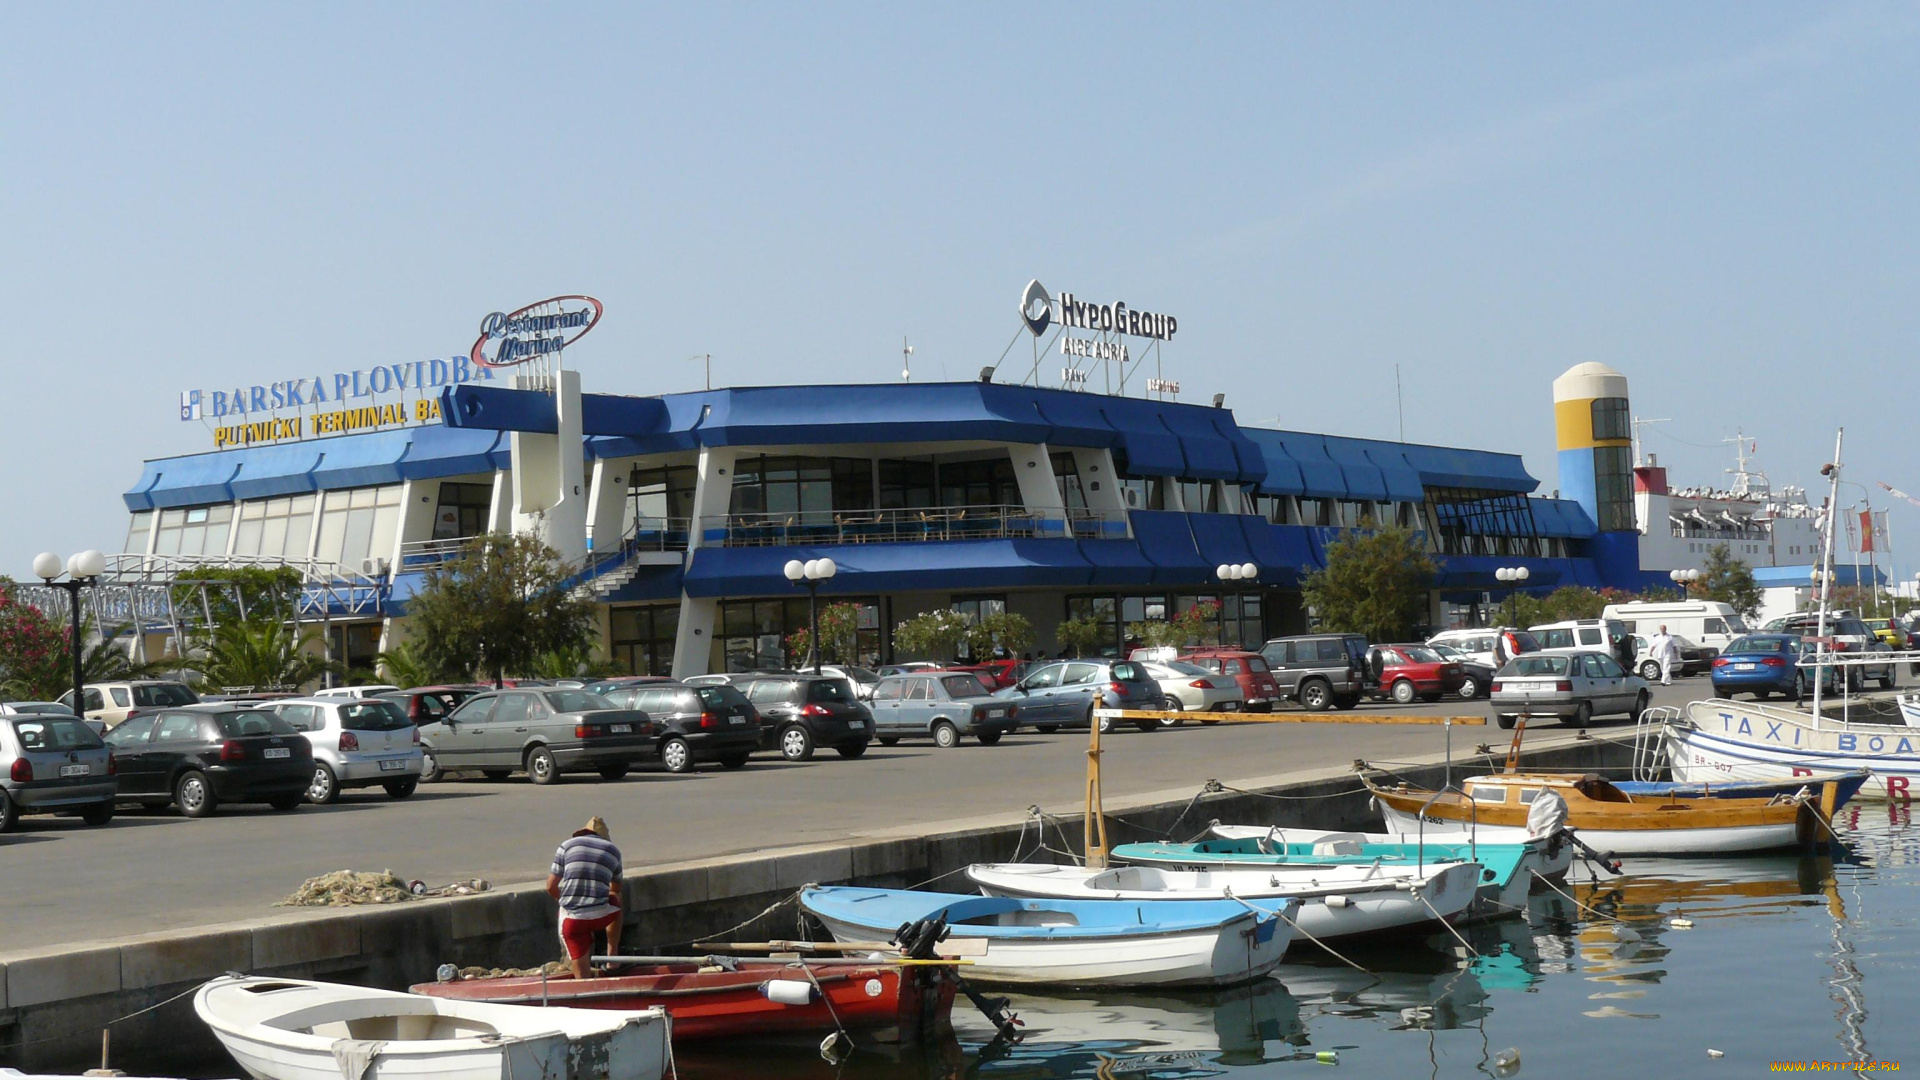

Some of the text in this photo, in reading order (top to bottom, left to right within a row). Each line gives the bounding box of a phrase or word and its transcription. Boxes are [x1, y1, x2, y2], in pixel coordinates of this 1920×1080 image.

[481, 307, 591, 340] Restaurant
[490, 333, 564, 363] Marina
[1062, 337, 1130, 362] ALPE ADRIA
[212, 352, 495, 417] BARSKA PLOVIDBA
[311, 403, 407, 435] TERMINAL
[1718, 712, 1801, 745] TAXI
